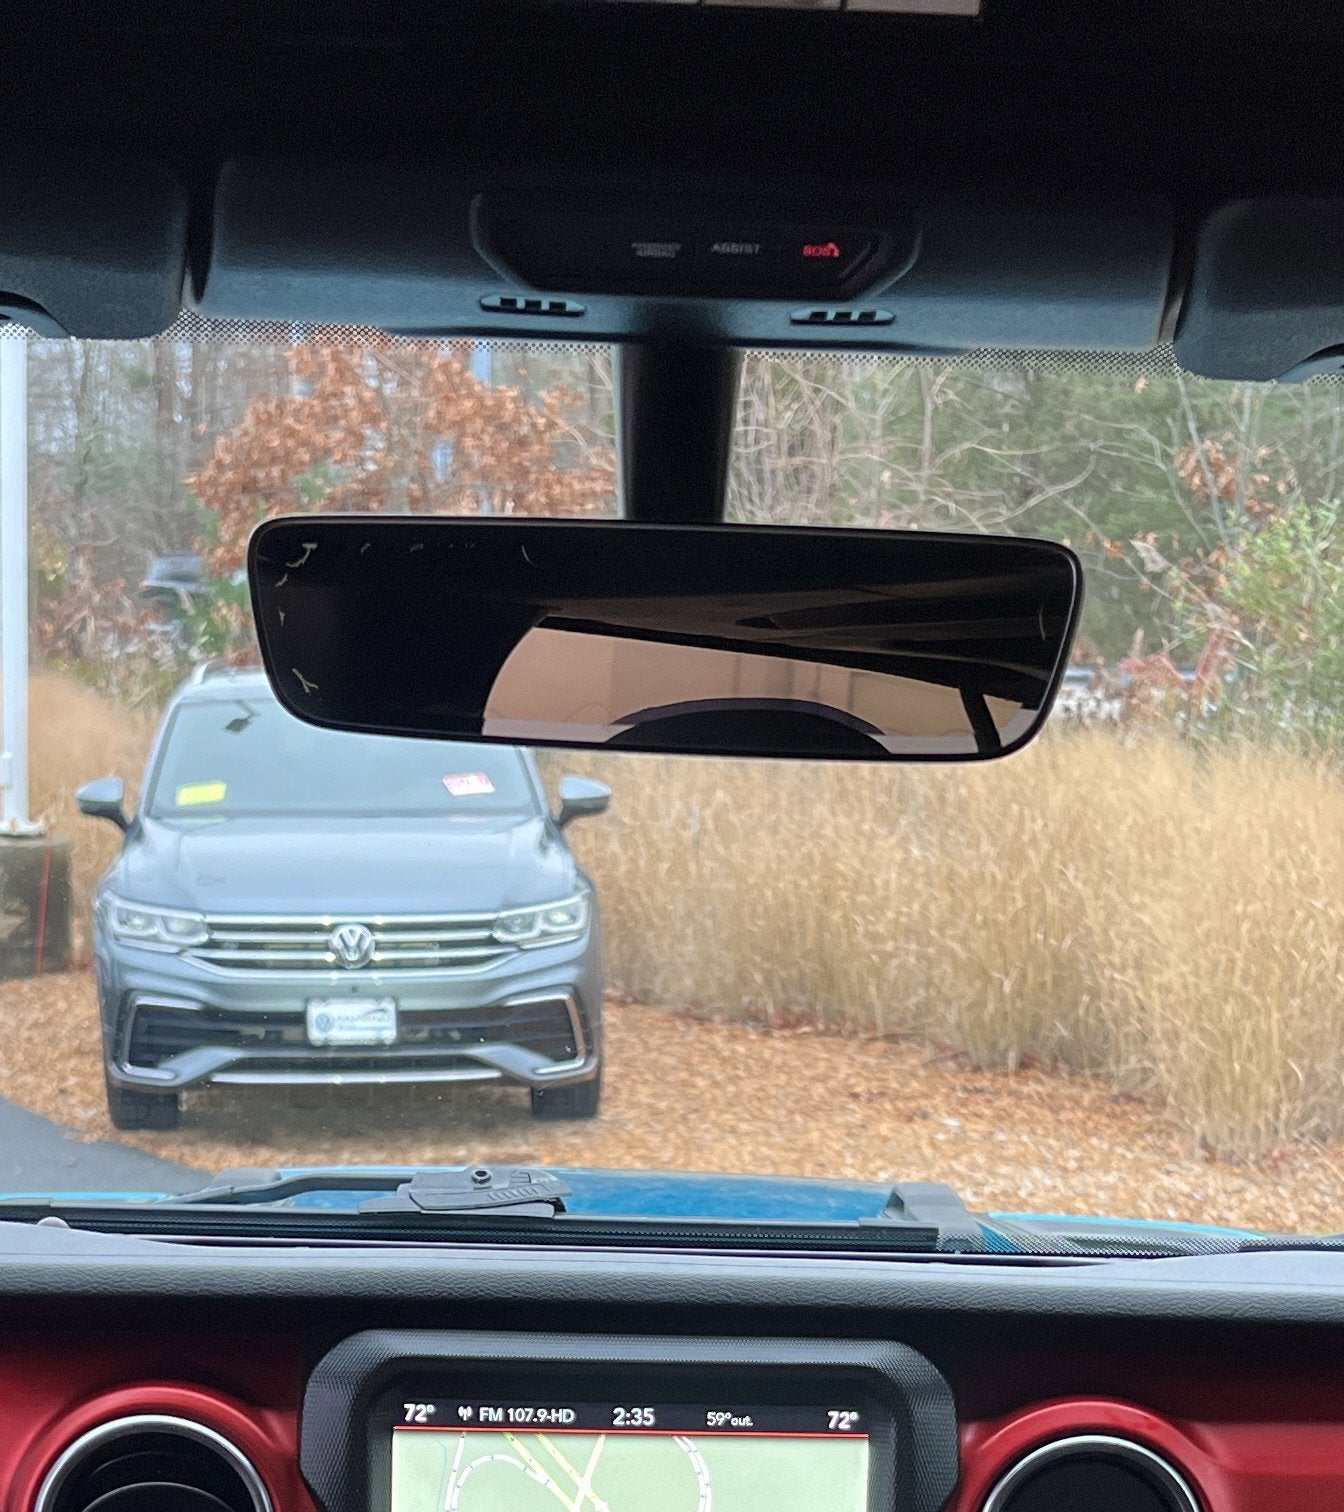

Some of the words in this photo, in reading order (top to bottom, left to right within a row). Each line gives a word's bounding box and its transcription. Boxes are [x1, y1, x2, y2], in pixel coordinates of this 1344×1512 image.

[404, 1403, 436, 1423] 72°
[479, 1408, 503, 1422] FM
[507, 1408, 575, 1424] 107.9-HD
[612, 1407, 655, 1425] 2:35
[827, 1410, 860, 1429] 72°
